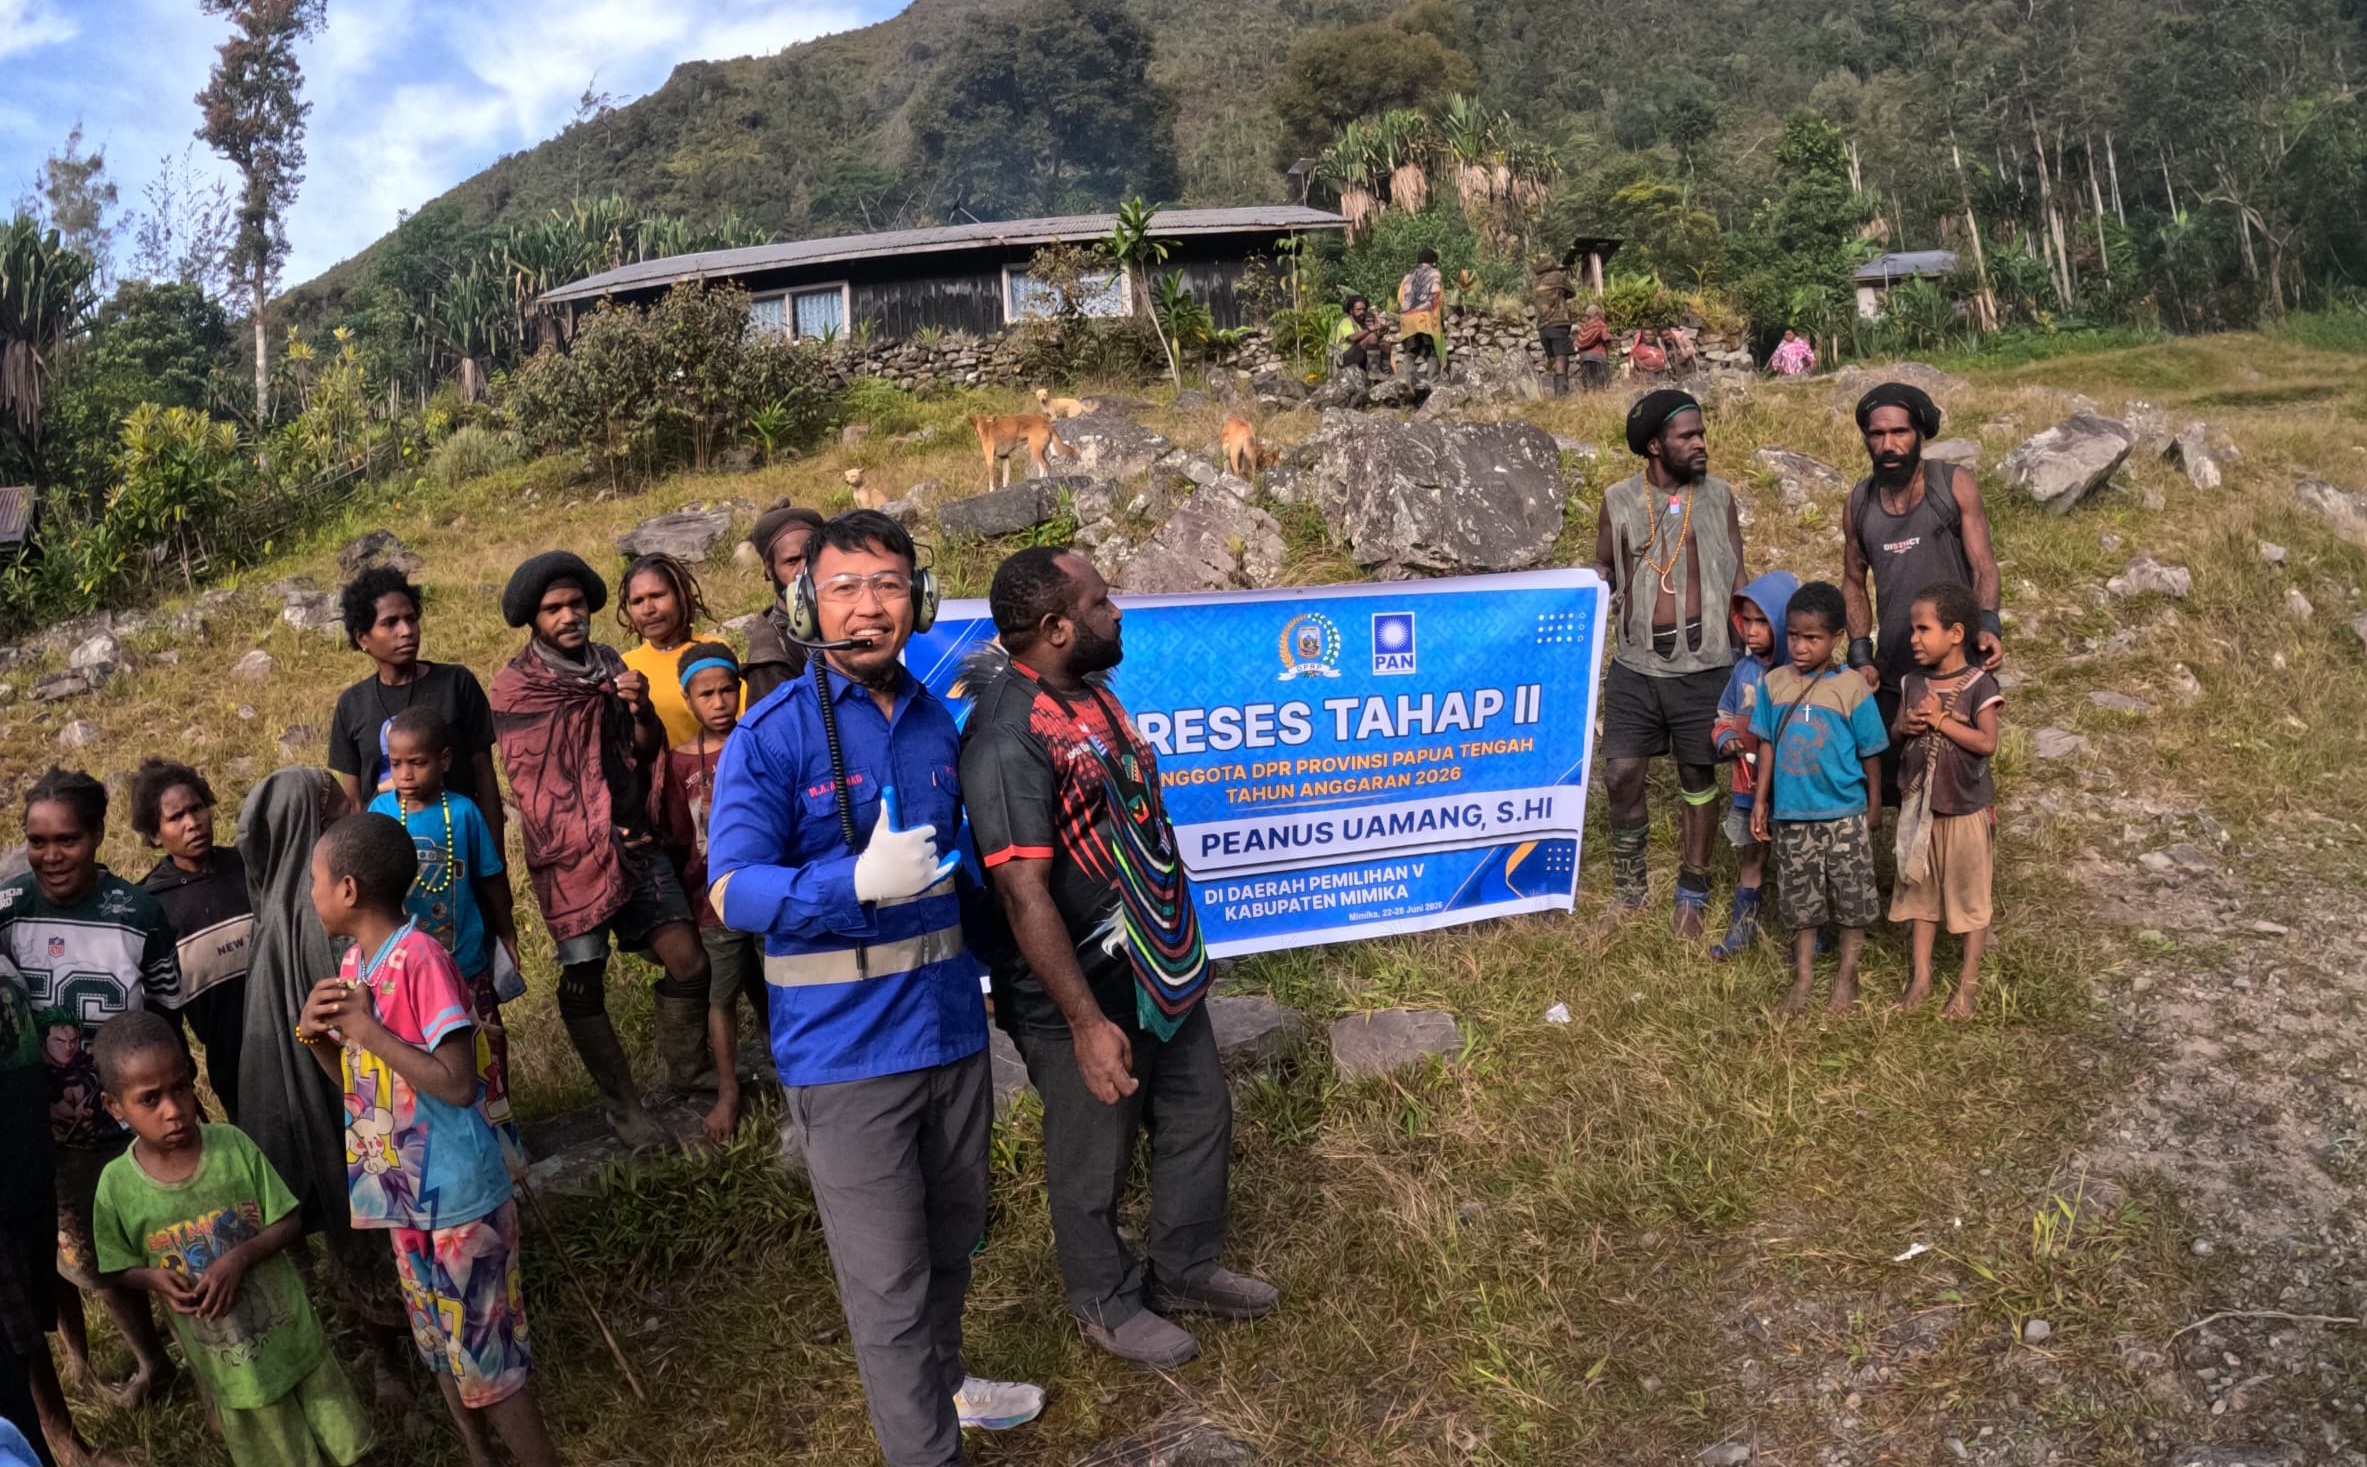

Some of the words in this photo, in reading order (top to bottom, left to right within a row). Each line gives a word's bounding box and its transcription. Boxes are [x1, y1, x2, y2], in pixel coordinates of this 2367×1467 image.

[1374, 655, 1414, 670] PAN
[1136, 700, 1313, 756] RESES
[1323, 687, 1505, 742] TAHAP
[1513, 683, 1542, 725] II
[1160, 764, 1247, 788] NGGOTA
[1252, 760, 1292, 779] DPR
[1296, 752, 1388, 776] PROVINSI
[1392, 746, 1455, 767] PAPUA
[1460, 737, 1535, 758] TENGAH
[1226, 784, 1295, 804] TAHUN
[1300, 772, 1412, 798] ANGGARAN
[1415, 766, 1462, 786] 2026
[1201, 821, 1334, 858] PEANUS
[1342, 803, 1487, 841] UAMANG,
[1496, 796, 1553, 824] S.HI
[1204, 887, 1224, 905] DI
[1227, 877, 1305, 902] DAERAH
[1309, 866, 1409, 892] PEMILIHAN
[1412, 863, 1425, 878] V
[1224, 892, 1337, 922] KABUPATEN
[1340, 884, 1409, 907] MIMIKA
[1349, 911, 1380, 921] Mimika,
[1406, 904, 1424, 914] Juni
[216, 936, 245, 956] NEW
